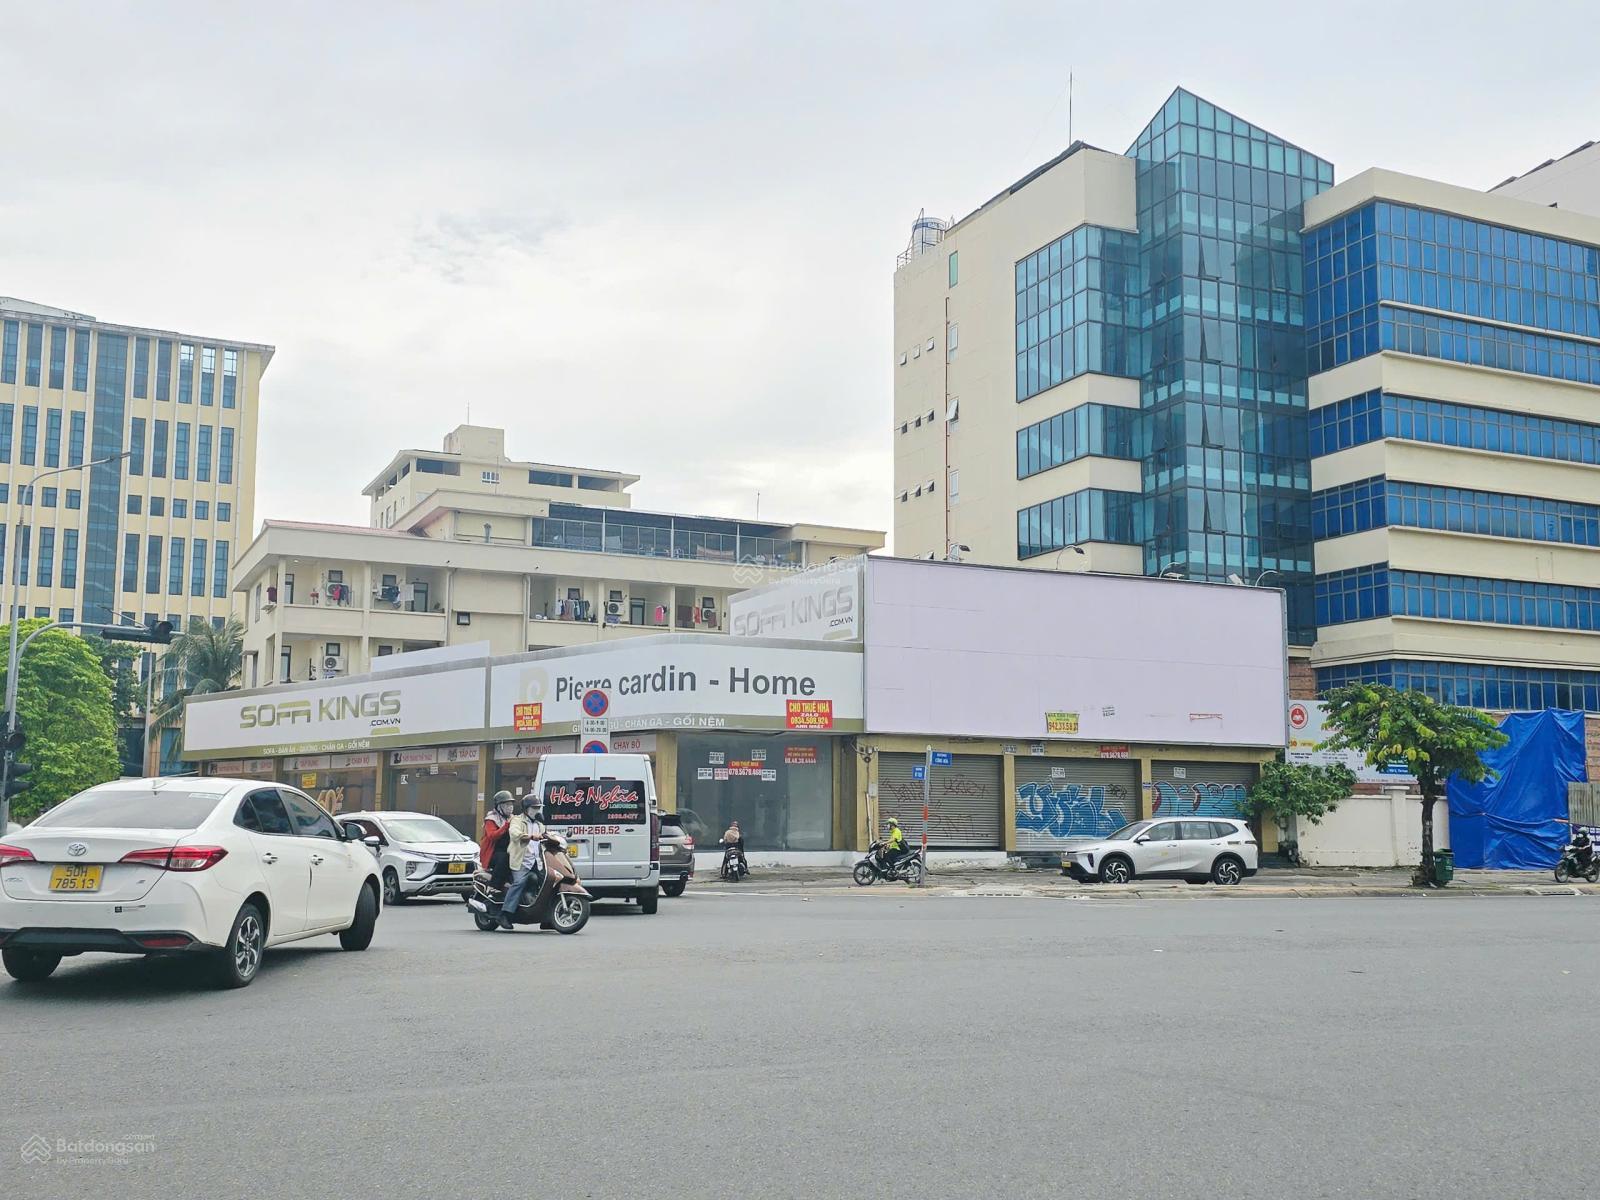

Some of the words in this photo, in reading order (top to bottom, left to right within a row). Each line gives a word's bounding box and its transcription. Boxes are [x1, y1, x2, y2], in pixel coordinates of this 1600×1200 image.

[734, 604, 786, 636] SOFA
[792, 585, 853, 626] KINGS
[619, 665, 696, 695] cardin
[729, 667, 816, 696] Home
[240, 700, 311, 729] SOFA
[318, 690, 402, 722] KINGS
[788, 702, 801, 712] CHO
[370, 717, 401, 727] .COM.VN
[649, 718, 663, 727] GA
[673, 714, 695, 726] GỐI
[66, 866, 88, 877] 50H
[55, 878, 95, 889] 785.13
